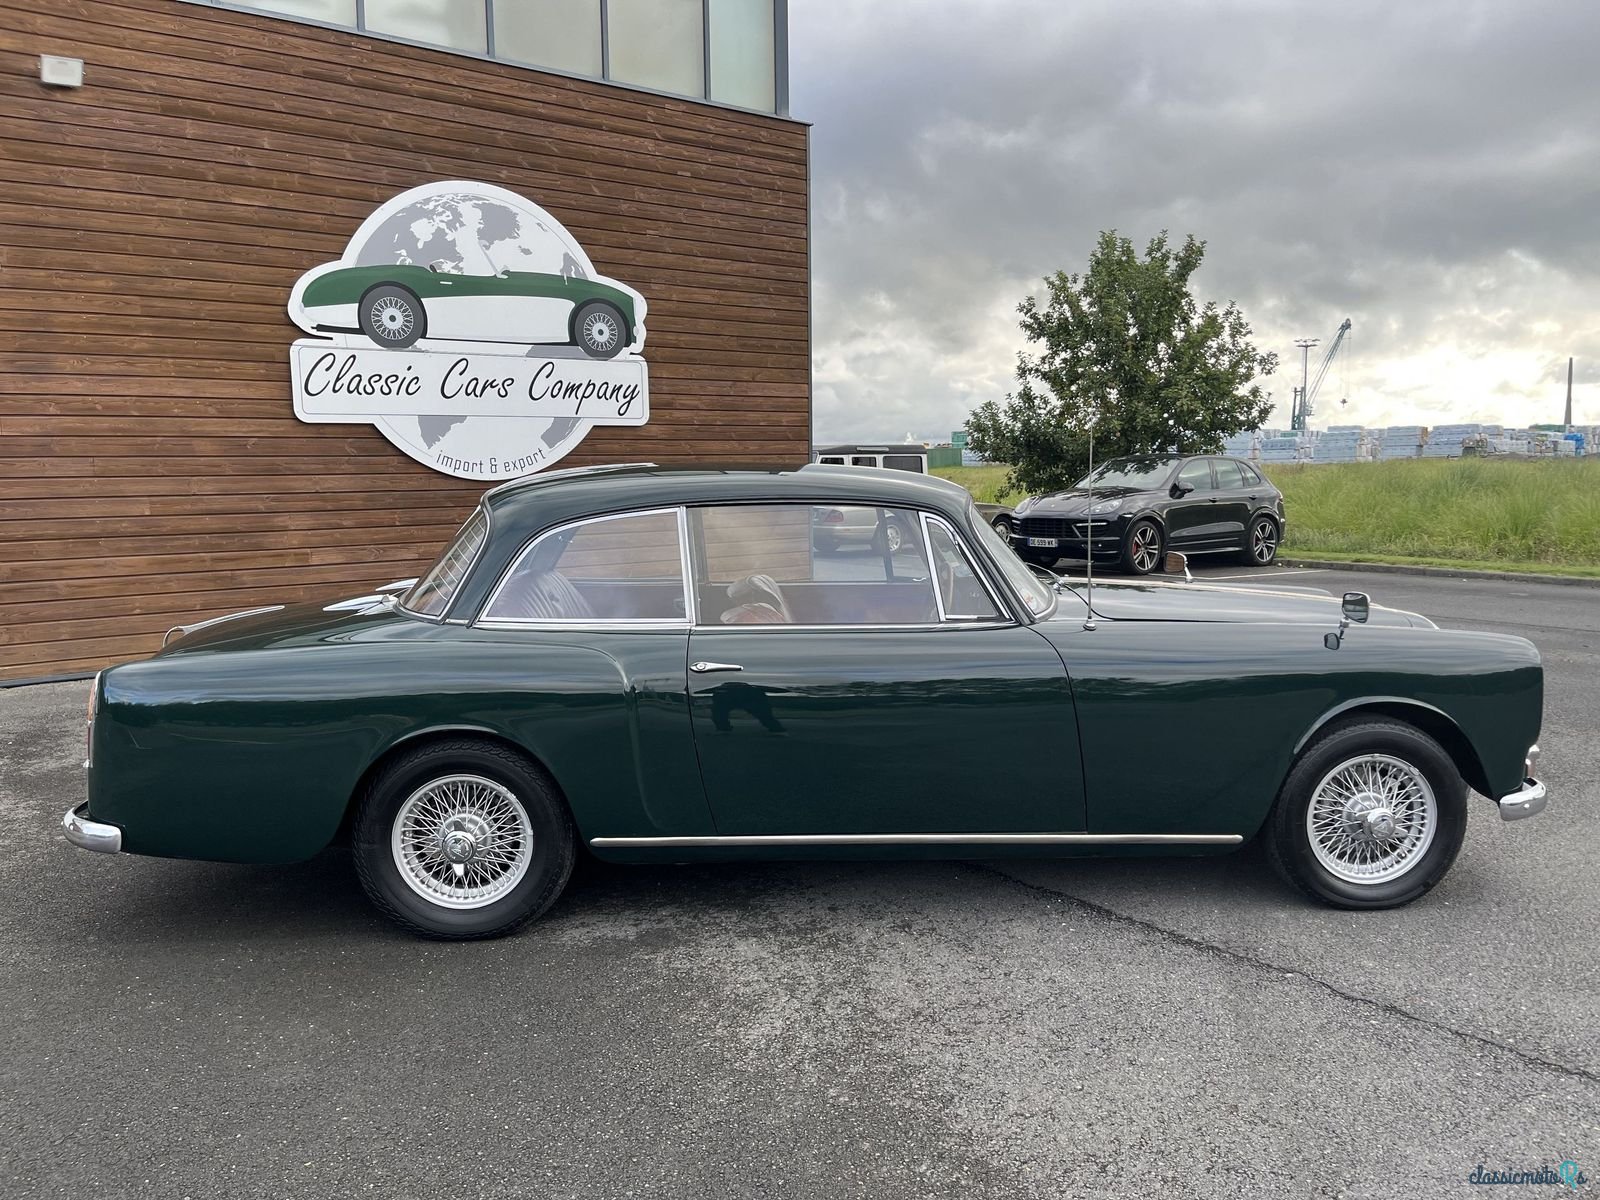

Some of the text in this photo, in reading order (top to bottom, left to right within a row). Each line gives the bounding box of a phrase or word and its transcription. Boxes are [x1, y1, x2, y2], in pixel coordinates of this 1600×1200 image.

[304, 352, 640, 416] Classic Cars Company
[436, 447, 546, 474] import & export
